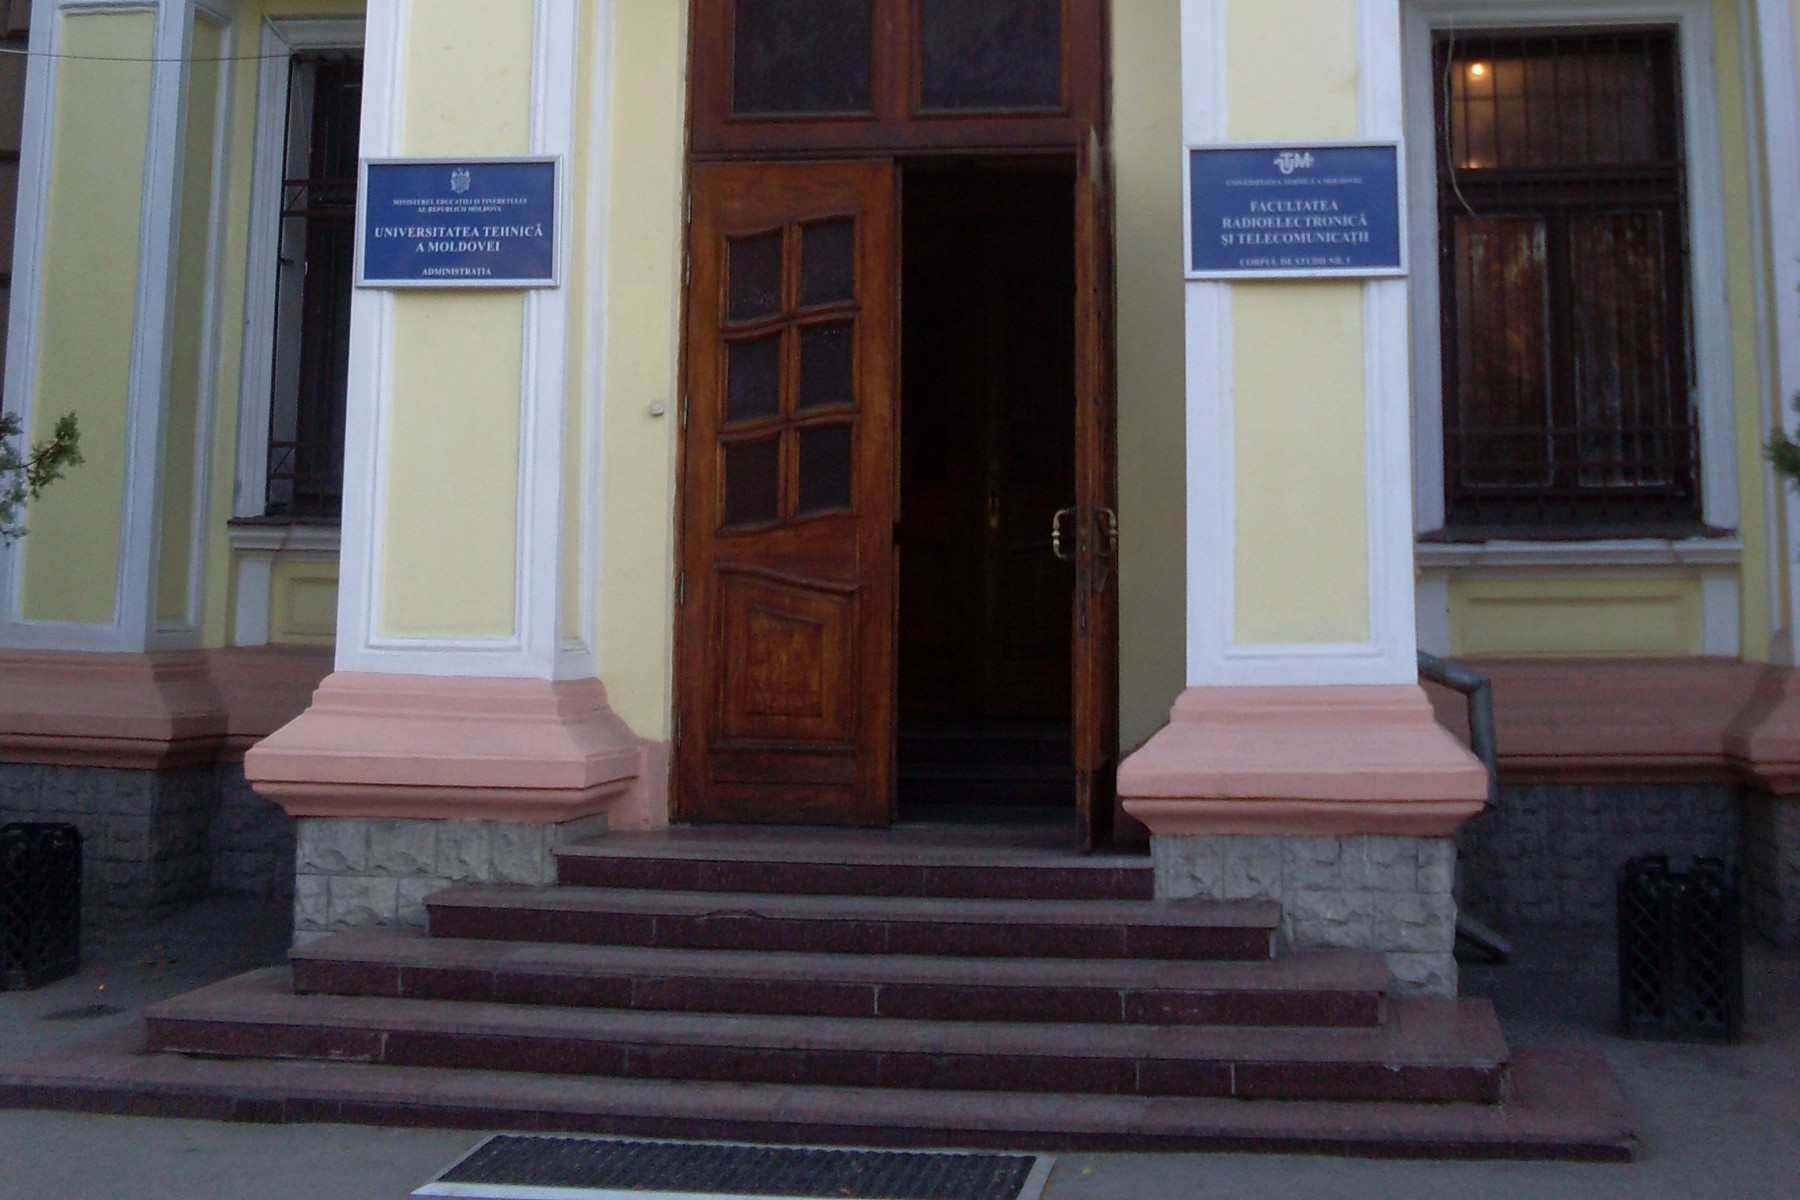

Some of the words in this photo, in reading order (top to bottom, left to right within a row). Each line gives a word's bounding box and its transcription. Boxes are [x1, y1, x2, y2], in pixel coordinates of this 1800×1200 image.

[1249, 200, 1339, 212] FACULTATEA
[1222, 213, 1368, 229] RADIOELECTRONICĂ
[374, 226, 480, 238] UNIVERSITATEA
[483, 223, 544, 238] TEHNICĂ
[416, 241, 425, 253] A
[427, 241, 501, 253] MOLDOVEI
